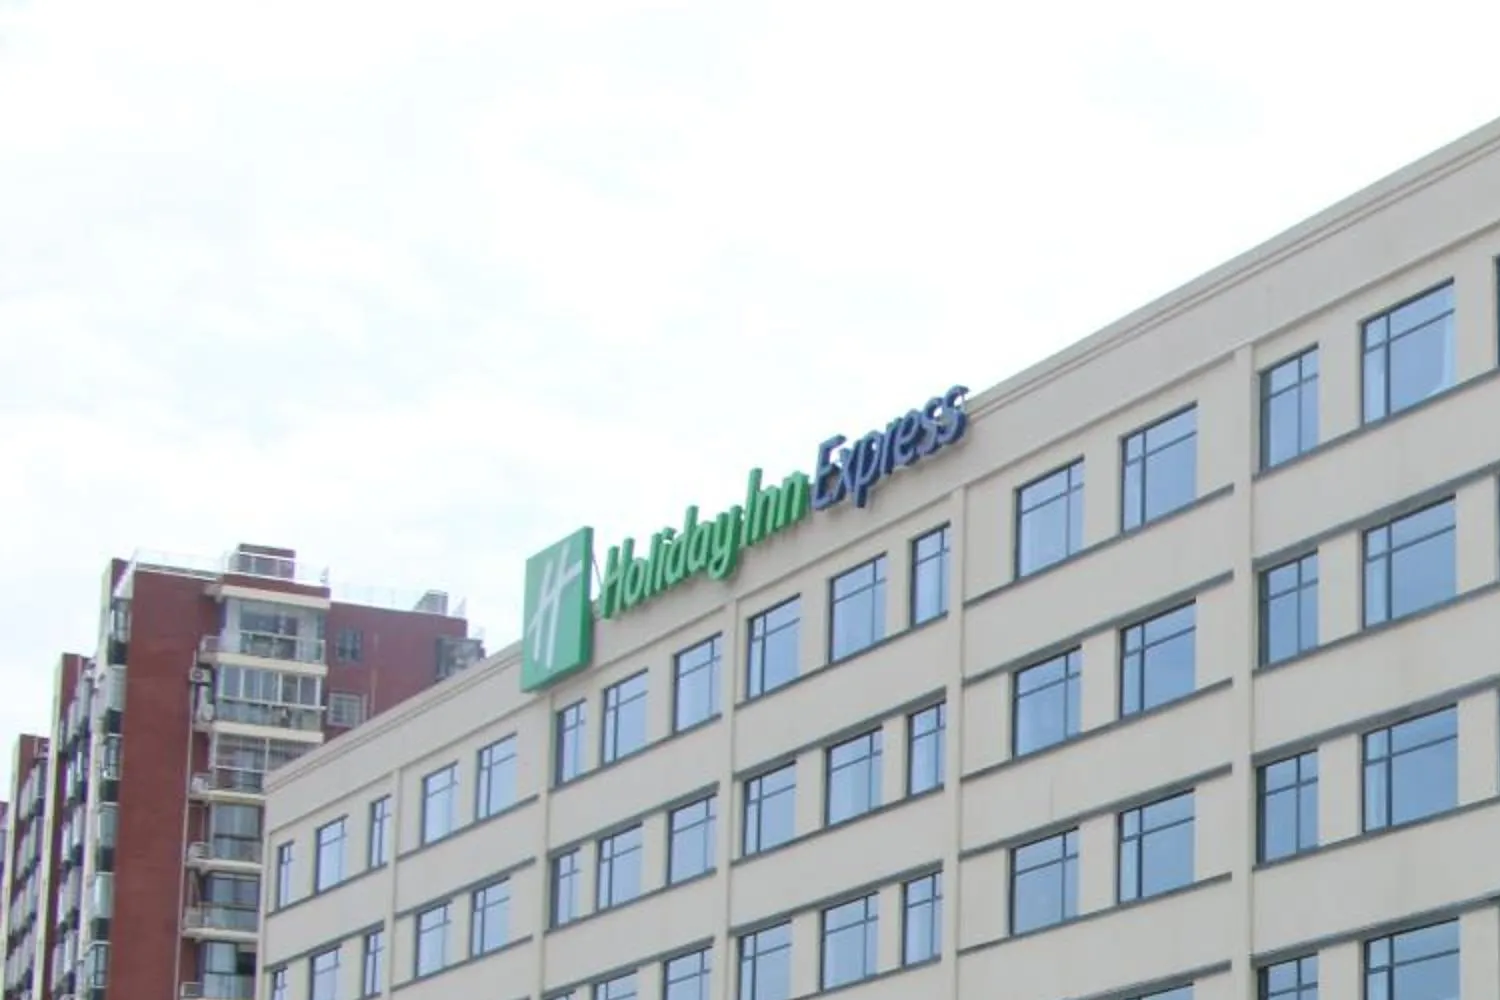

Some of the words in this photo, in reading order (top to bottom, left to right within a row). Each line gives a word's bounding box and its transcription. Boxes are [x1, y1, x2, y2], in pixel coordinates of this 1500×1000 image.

[600, 504, 743, 620] Holiday
[740, 467, 812, 548] Inn
[810, 384, 969, 511] Express
